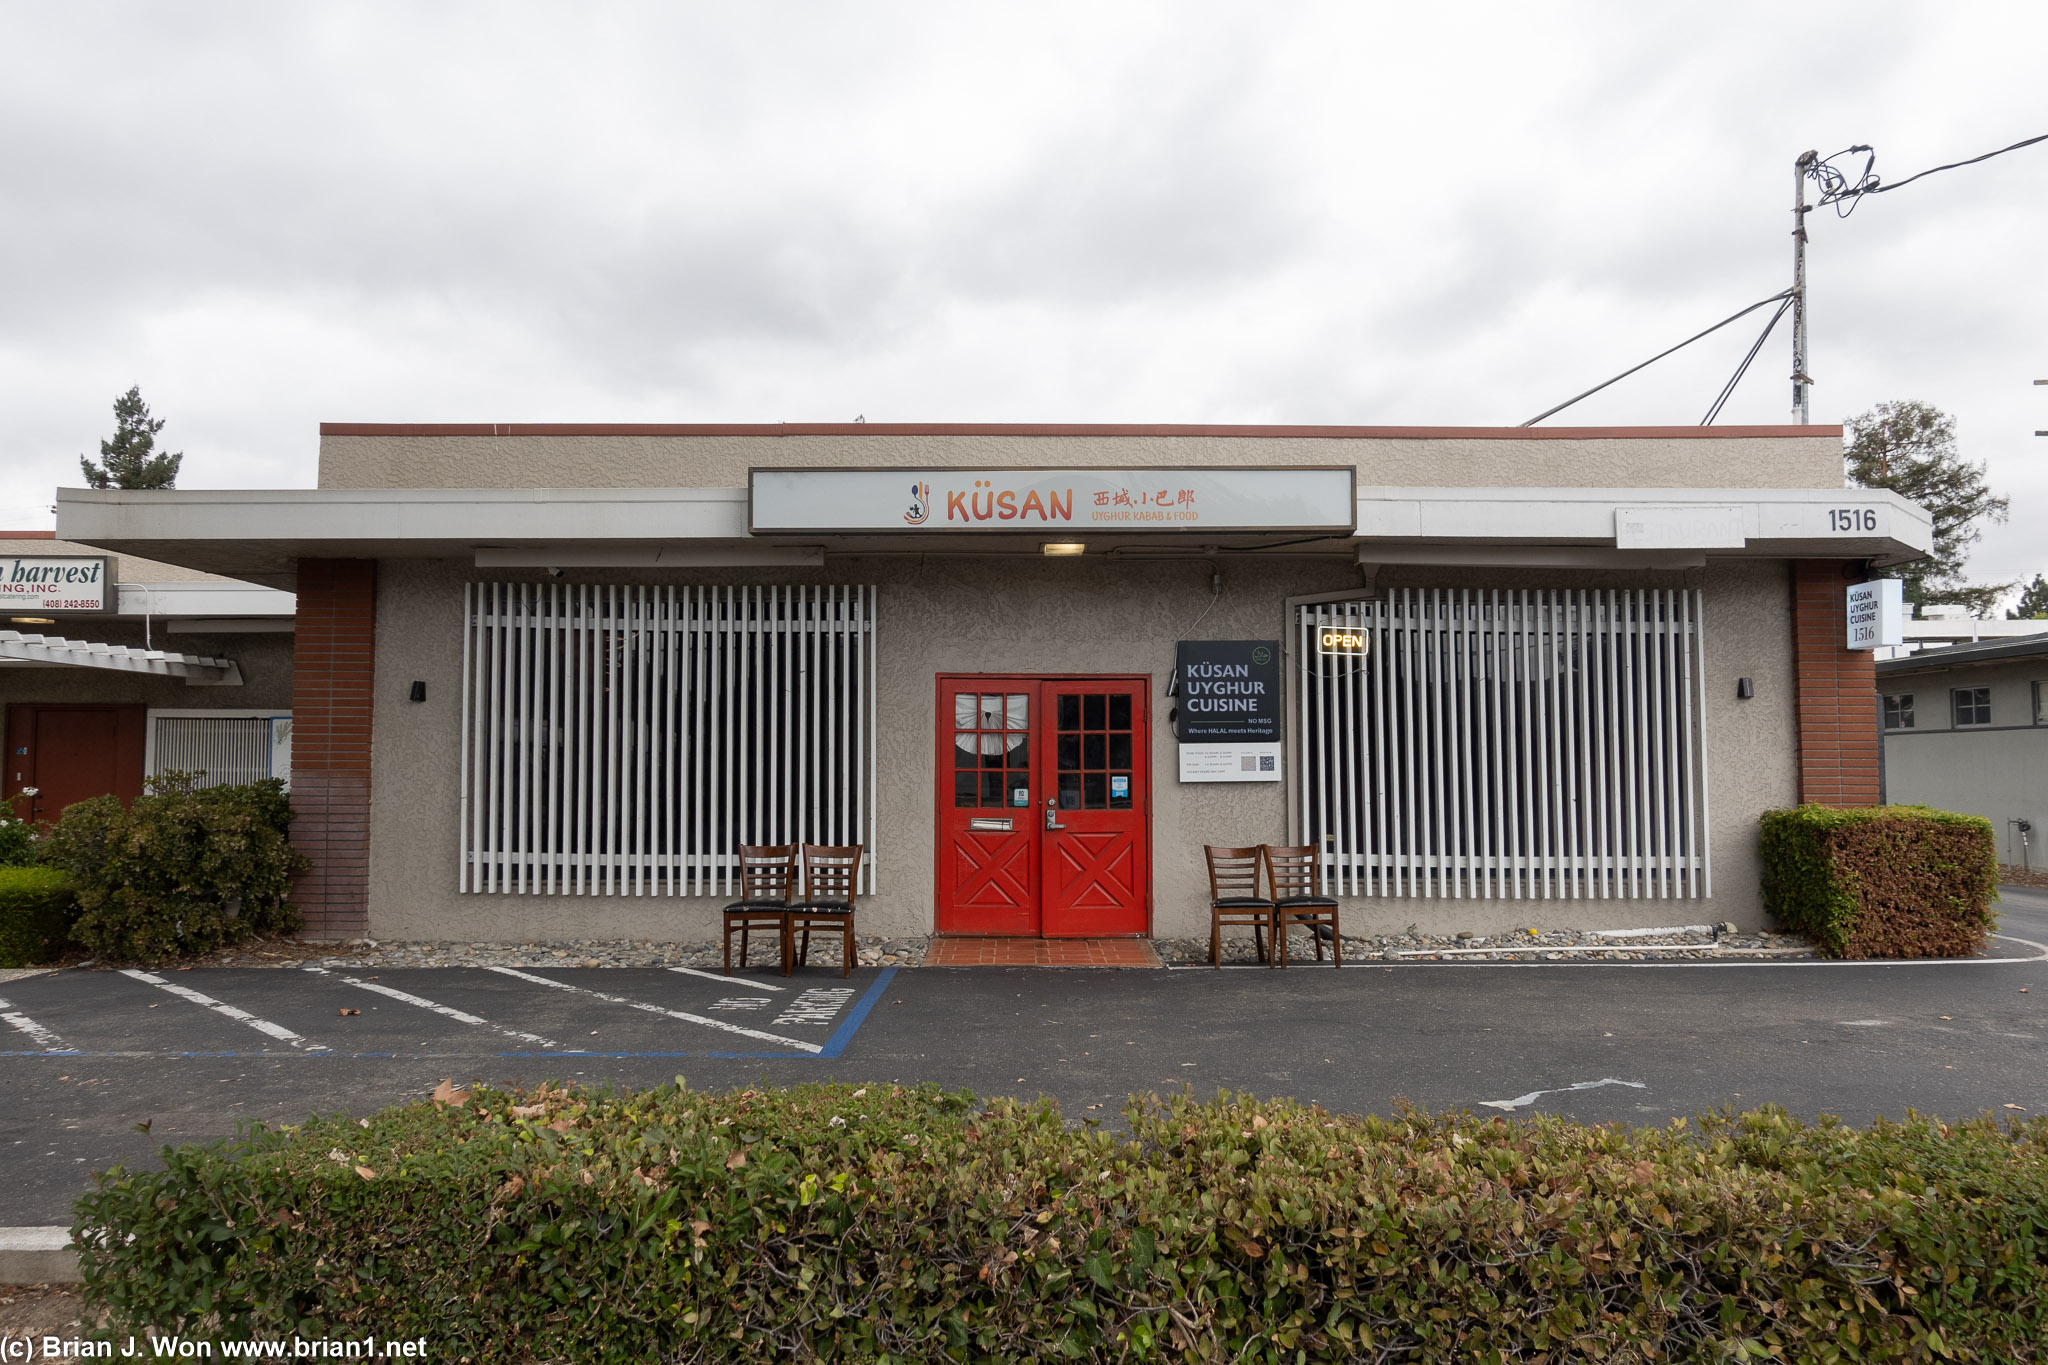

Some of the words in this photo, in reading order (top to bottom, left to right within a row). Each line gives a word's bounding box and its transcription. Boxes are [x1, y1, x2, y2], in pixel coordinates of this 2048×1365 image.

[947, 480, 1073, 522] KÜSAN
[1091, 511, 1131, 521] UYGHUR
[1133, 511, 1165, 521] KABAB
[1166, 511, 1172, 521] &
[1174, 511, 1199, 521] FOOD
[1828, 509, 1877, 532] 1516
[10, 560, 101, 583] harvest
[1850, 590, 1873, 603] KÜSAN
[42, 600, 62, 609] (408)
[64, 600, 100, 609] 242-8550
[1850, 601, 1878, 614] UYGHUR
[1850, 612, 1876, 625] CUISINE
[1323, 634, 1363, 648] OPEN
[1854, 626, 1875, 642] 1516
[1187, 661, 1249, 678] KÜSAN
[1187, 681, 1265, 695] UYGHUR
[1187, 698, 1258, 712] CUISINE
